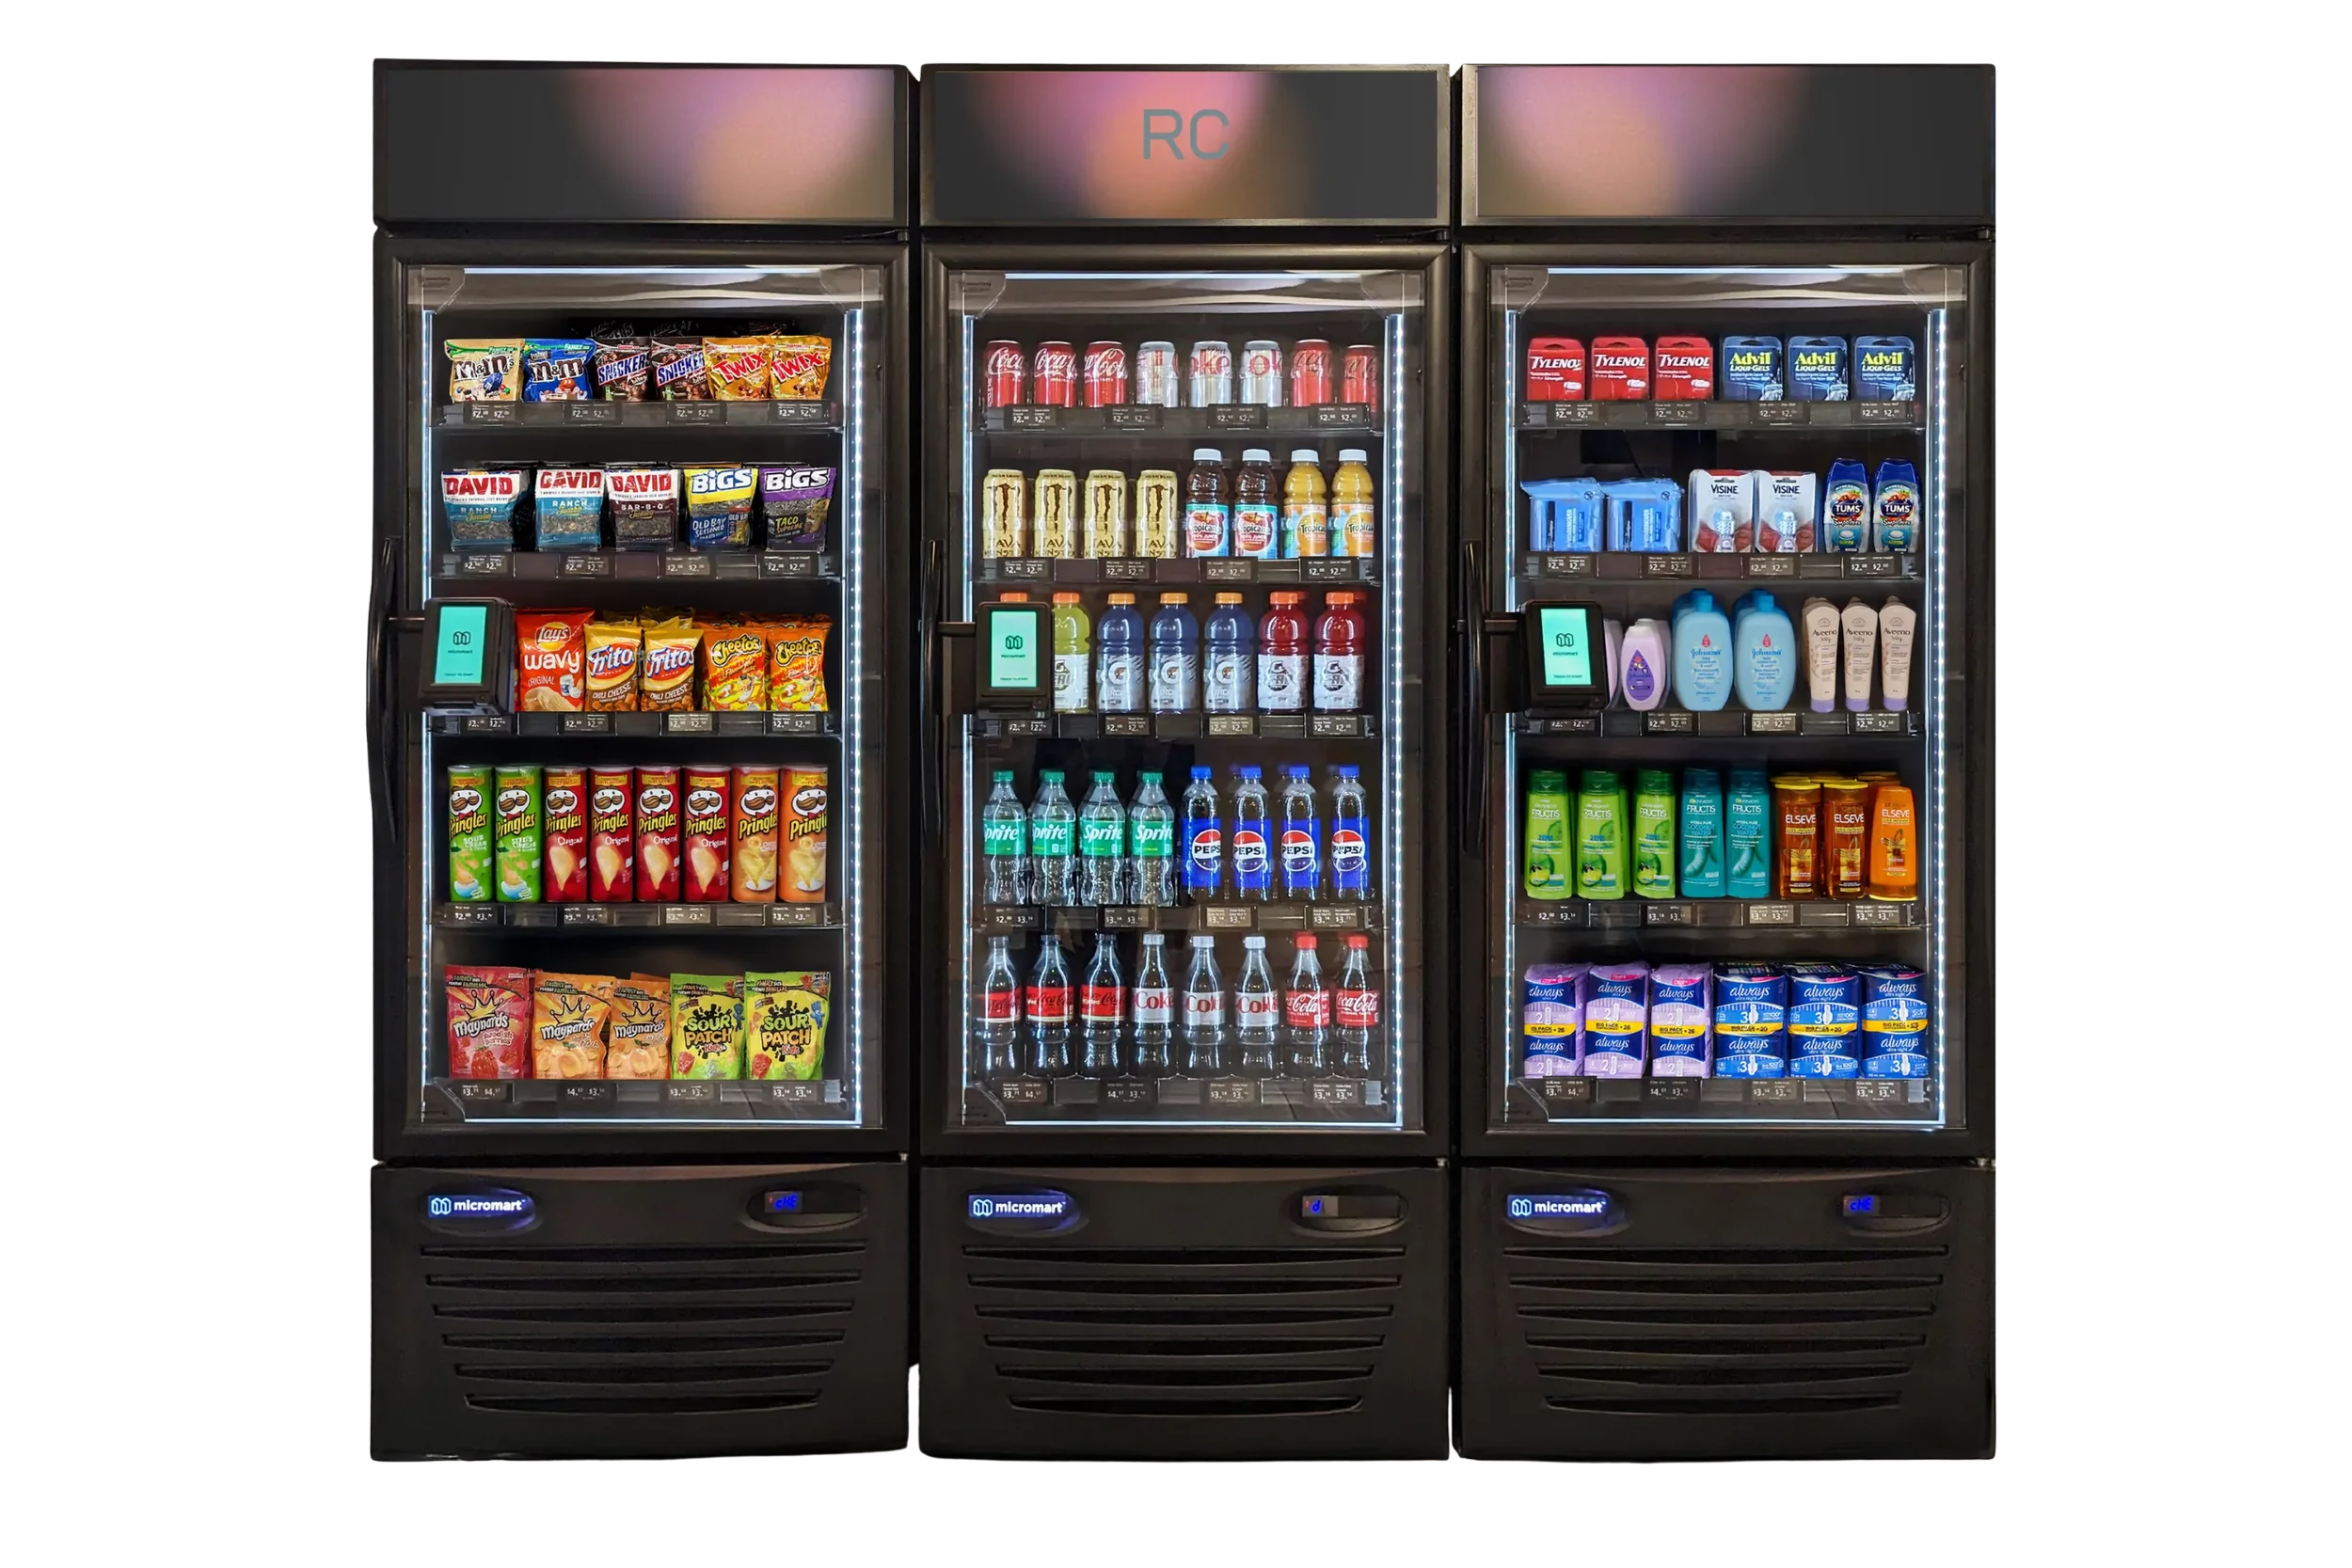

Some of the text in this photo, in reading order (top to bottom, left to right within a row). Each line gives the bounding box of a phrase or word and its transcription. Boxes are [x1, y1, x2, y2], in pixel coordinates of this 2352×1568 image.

[1143, 109, 1230, 159] RC
[1595, 354, 1645, 368] TYLENOL
[1659, 354, 1709, 368] TYLENOL
[1730, 352, 1771, 365] Advil
[1795, 352, 1836, 365] Advil
[1862, 352, 1903, 365] Advil
[445, 477, 513, 495] DAVID
[540, 471, 601, 489] DAVID
[612, 474, 672, 491] DAVID
[1710, 483, 1739, 494] VISINE
[1773, 484, 1800, 494] VISINE
[621, 502, 664, 512] BAR-B-Q
[692, 517, 726, 531] OLD BAY
[775, 516, 798, 528] TACO
[695, 525, 724, 538] SEASONED
[711, 635, 761, 666] Cheetos
[524, 654, 580, 673] wavy
[608, 682, 631, 697] CHEESE
[664, 686, 687, 699] CHEESE
[1532, 809, 1560, 818] FRUCTIS
[1640, 809, 1667, 817] FRUCTIS
[1835, 814, 1864, 823] ELSEVE
[1882, 809, 1910, 817] ELSEVE
[592, 813, 628, 835] Pringles
[638, 813, 676, 836] Pringles
[1786, 815, 1816, 824] ELSEVE
[686, 816, 726, 837] Pringles
[1234, 847, 1264, 855] PEPSI
[1282, 847, 1312, 855] PEPSI
[1529, 988, 1564, 998] always
[1598, 982, 1632, 994] always
[1659, 988, 1694, 999] always
[1730, 985, 1770, 997] always
[1804, 985, 1844, 997] always
[1879, 982, 1916, 994] always
[1337, 992, 1377, 1013] Coca-Cola
[1536, 1013, 1543, 1023] 2
[1604, 1009, 1611, 1020] 2
[1667, 1013, 1674, 1023] 2
[687, 1014, 731, 1031] SOUR
[764, 1014, 809, 1031] SOUR
[685, 1030, 733, 1047] PATCH
[762, 1030, 811, 1047] PATCH
[1596, 1039, 1629, 1050] always
[1729, 1037, 1769, 1050] always
[1804, 1037, 1842, 1050] always
[1881, 1037, 1918, 1049] always
[781, 1045, 800, 1054] Kids
[1530, 1040, 1564, 1051] always
[1660, 1041, 1694, 1052] always
[1537, 1064, 1544, 1073] 2
[1602, 1060, 1609, 1071] 2
[1668, 1064, 1675, 1073] 2
[453, 1198, 522, 1212] micromart
[995, 1200, 1062, 1213] micromart
[1534, 1200, 1602, 1213] micromart
